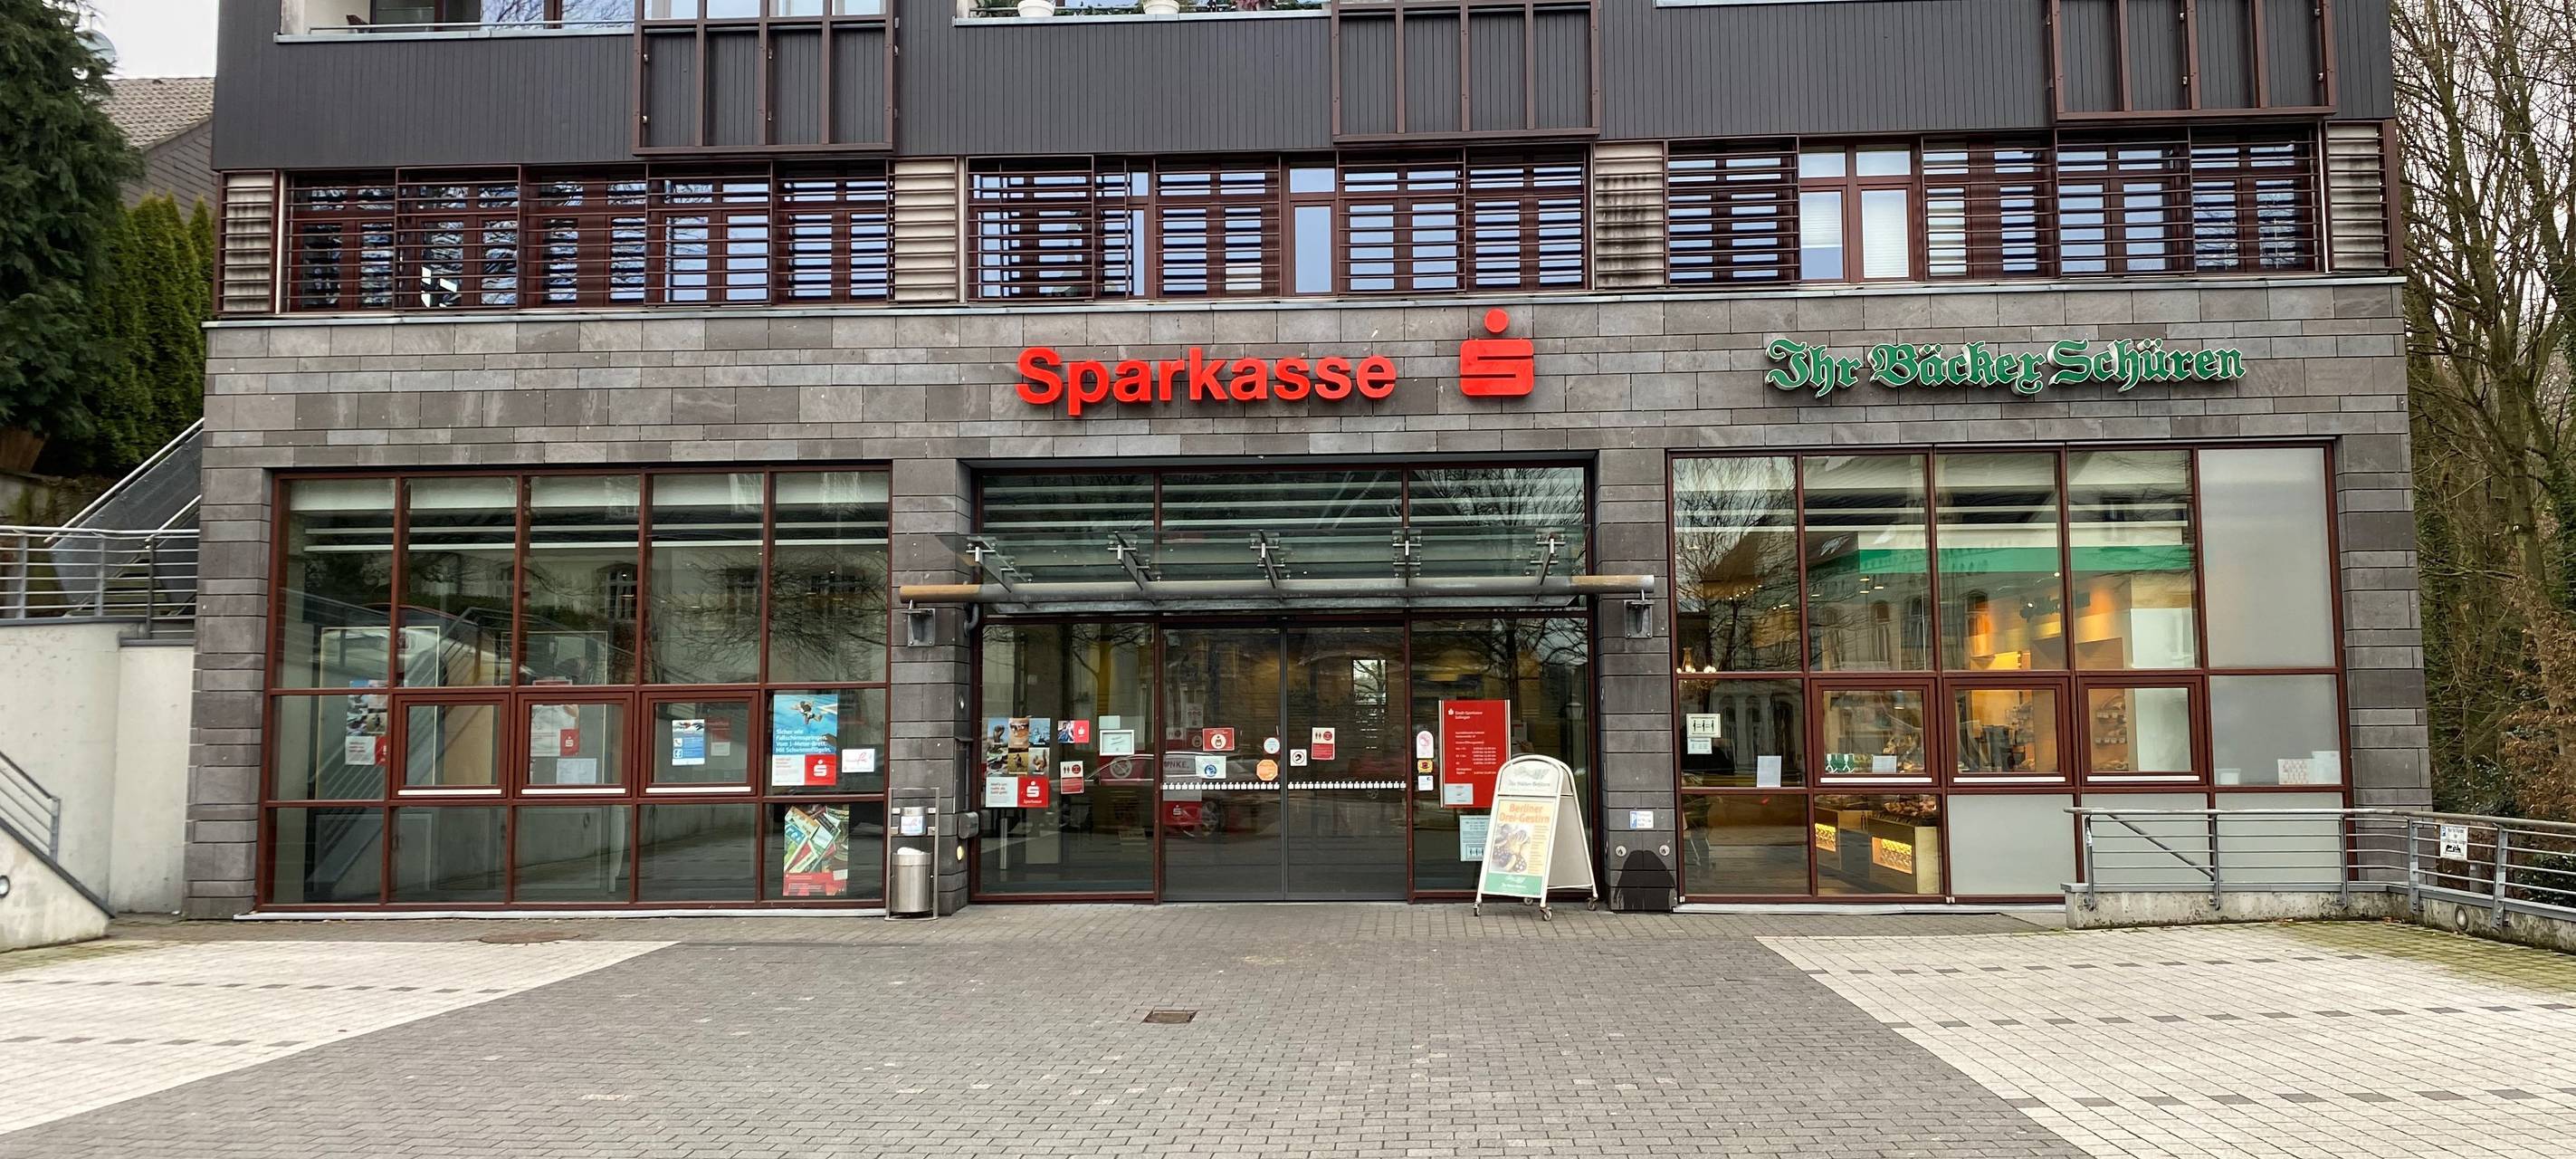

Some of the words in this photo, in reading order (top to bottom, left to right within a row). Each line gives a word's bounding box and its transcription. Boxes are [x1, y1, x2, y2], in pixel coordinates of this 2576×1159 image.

[1015, 346, 1397, 417] Sparkasse
[1765, 337, 1863, 398] Ihr
[1869, 340, 2046, 396] Bäcker
[2047, 338, 2246, 394] Schüren
[1499, 812, 1550, 823] Drei-Gestirn
[1509, 803, 1543, 812] Berliner
